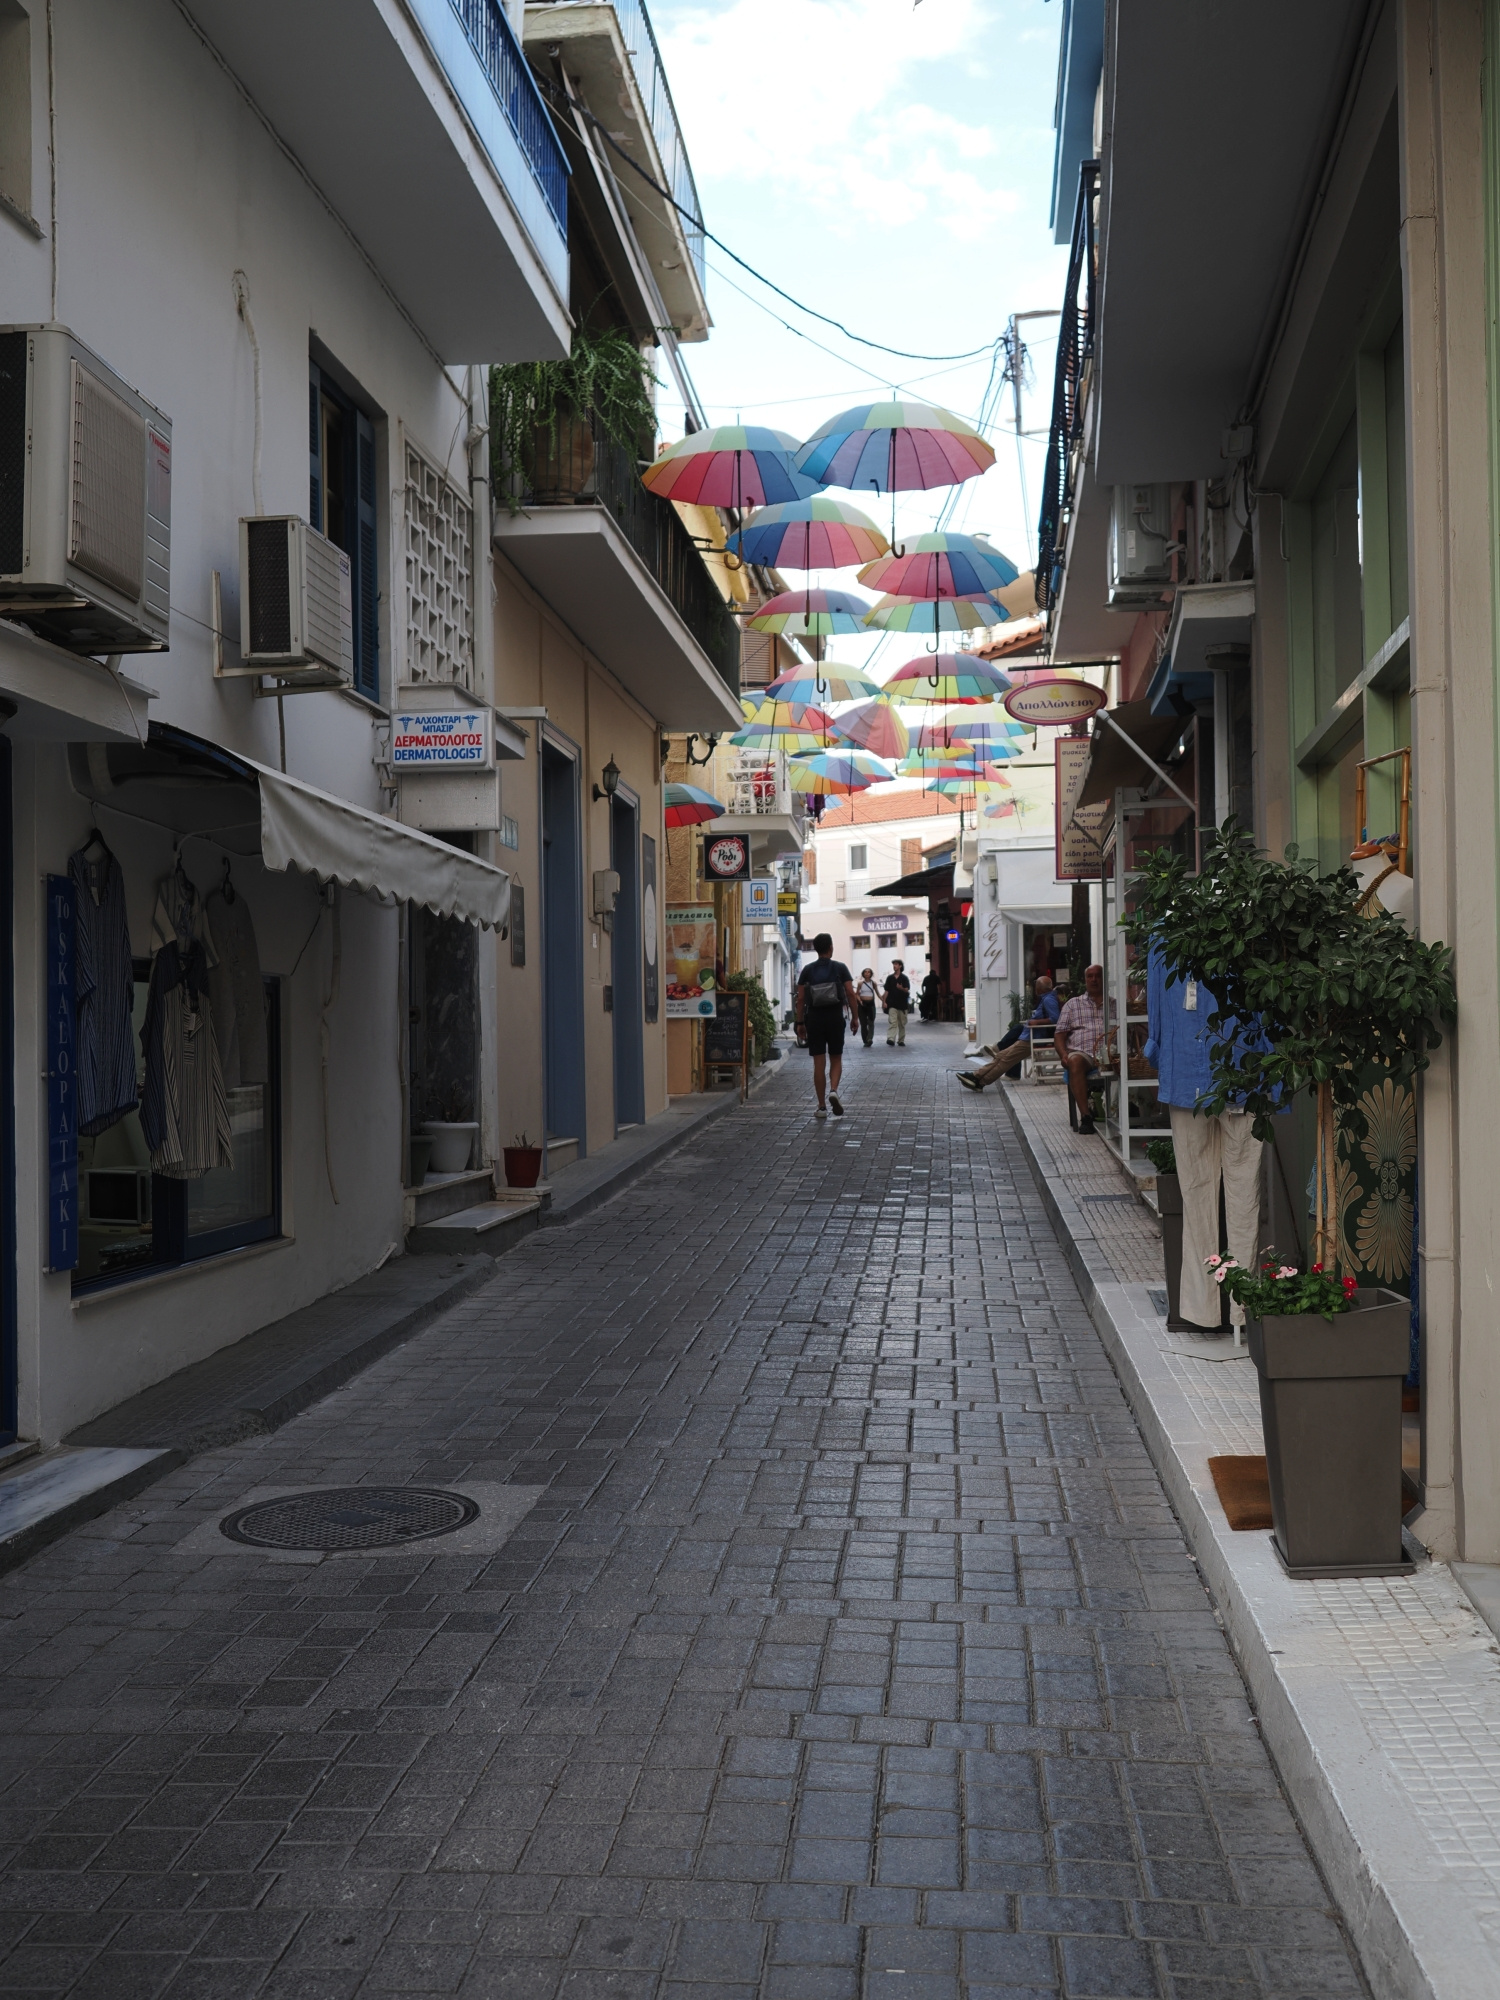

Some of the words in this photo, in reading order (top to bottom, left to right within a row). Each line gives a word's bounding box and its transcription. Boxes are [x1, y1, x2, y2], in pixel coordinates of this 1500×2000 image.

[415, 716, 461, 724] ΑΛΧΟΝΤΑΡΙ
[395, 734, 482, 747] ΔΕΡΜΑΤΟΛΟΓΟΣ
[395, 748, 482, 761] DERMATOLOGIST
[56, 894, 70, 920] To
[867, 920, 903, 931] MARKET
[57, 932, 70, 1252] SKALOPATAKI
